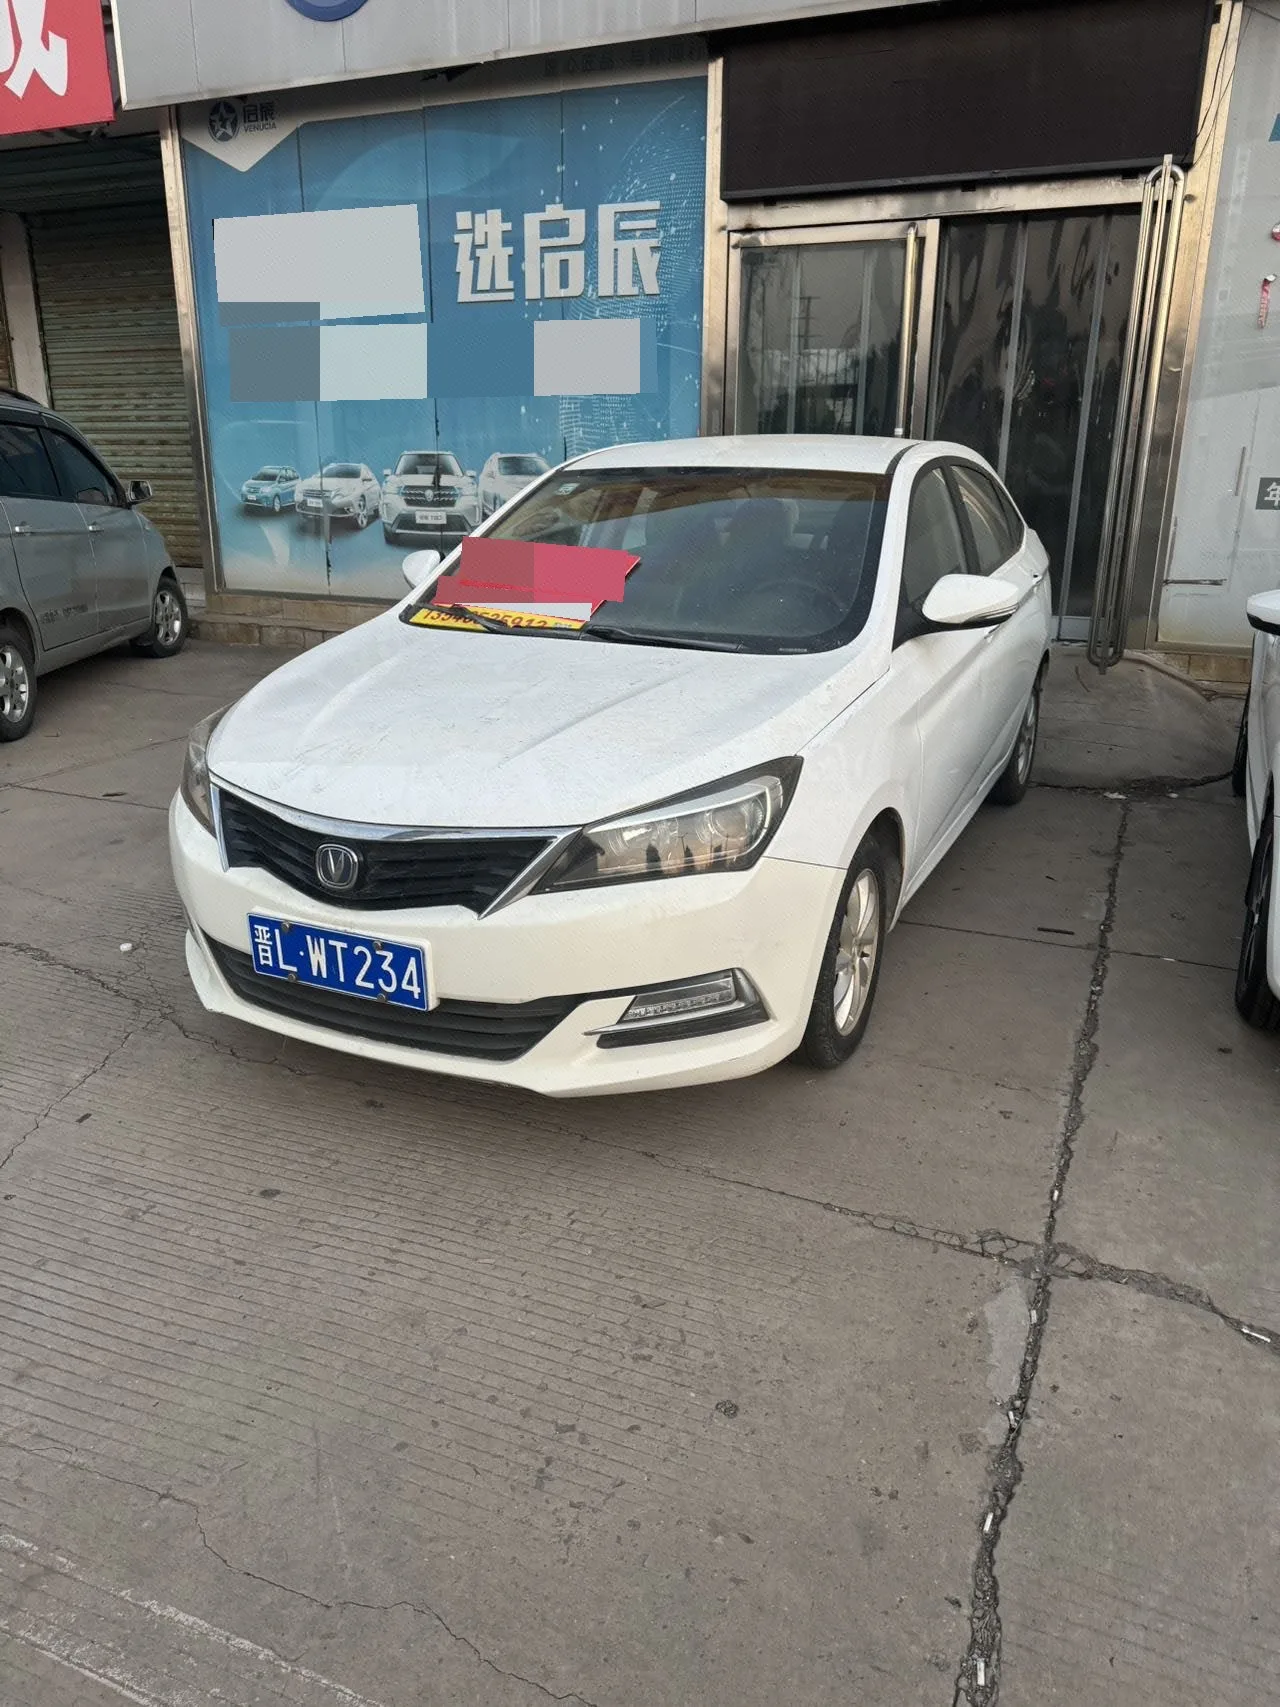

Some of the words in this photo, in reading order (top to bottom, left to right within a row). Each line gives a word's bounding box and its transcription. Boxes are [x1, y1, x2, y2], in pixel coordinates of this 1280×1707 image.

[243, 121, 277, 132] VENUCIA
[453, 200, 661, 303] 选启辰
